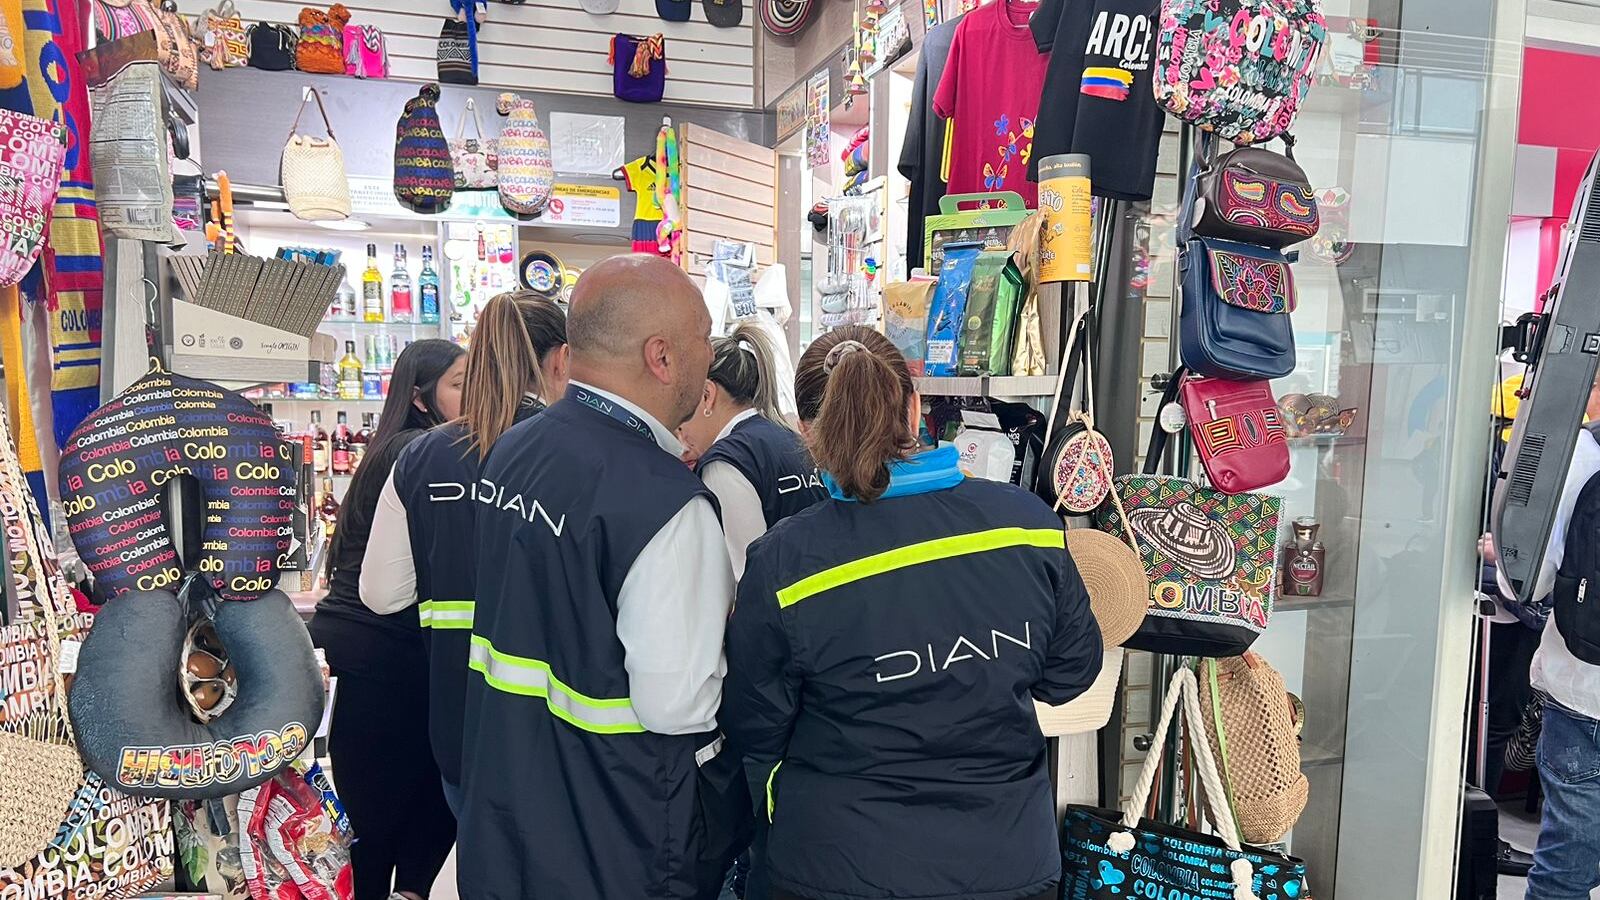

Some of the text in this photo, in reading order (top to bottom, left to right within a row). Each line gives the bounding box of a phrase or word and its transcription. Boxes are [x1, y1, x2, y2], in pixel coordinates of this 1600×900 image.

[122, 389, 172, 406] Colombia
[171, 388, 224, 399] Colombia
[576, 390, 613, 414] DIAN
[94, 409, 135, 428] Colombia
[134, 402, 173, 416] Colombia
[174, 401, 216, 410] Colombia
[76, 425, 126, 448] Colombia
[125, 414, 176, 433] Colombia
[80, 440, 131, 462] Colombia
[130, 429, 179, 447] Colombia
[177, 425, 229, 438] Colombia
[184, 441, 275, 460] Colombia
[87, 446, 181, 483] Colombia
[230, 486, 280, 496] Colombia
[102, 496, 156, 521] Colombia
[479, 478, 566, 537] DIAN
[108, 510, 161, 535] Colombia
[228, 527, 278, 537] Colombia
[95, 536, 137, 556] Colombia
[120, 536, 170, 562] Colombia
[126, 550, 175, 575] Colombia
[1147, 581, 1268, 628] OMBIA
[875, 621, 1031, 683] DIAN
[1162, 850, 1209, 868] COLOMBIA
[1163, 837, 1223, 858] COLOMBIA
[75, 868, 153, 900] COLOMBIA
